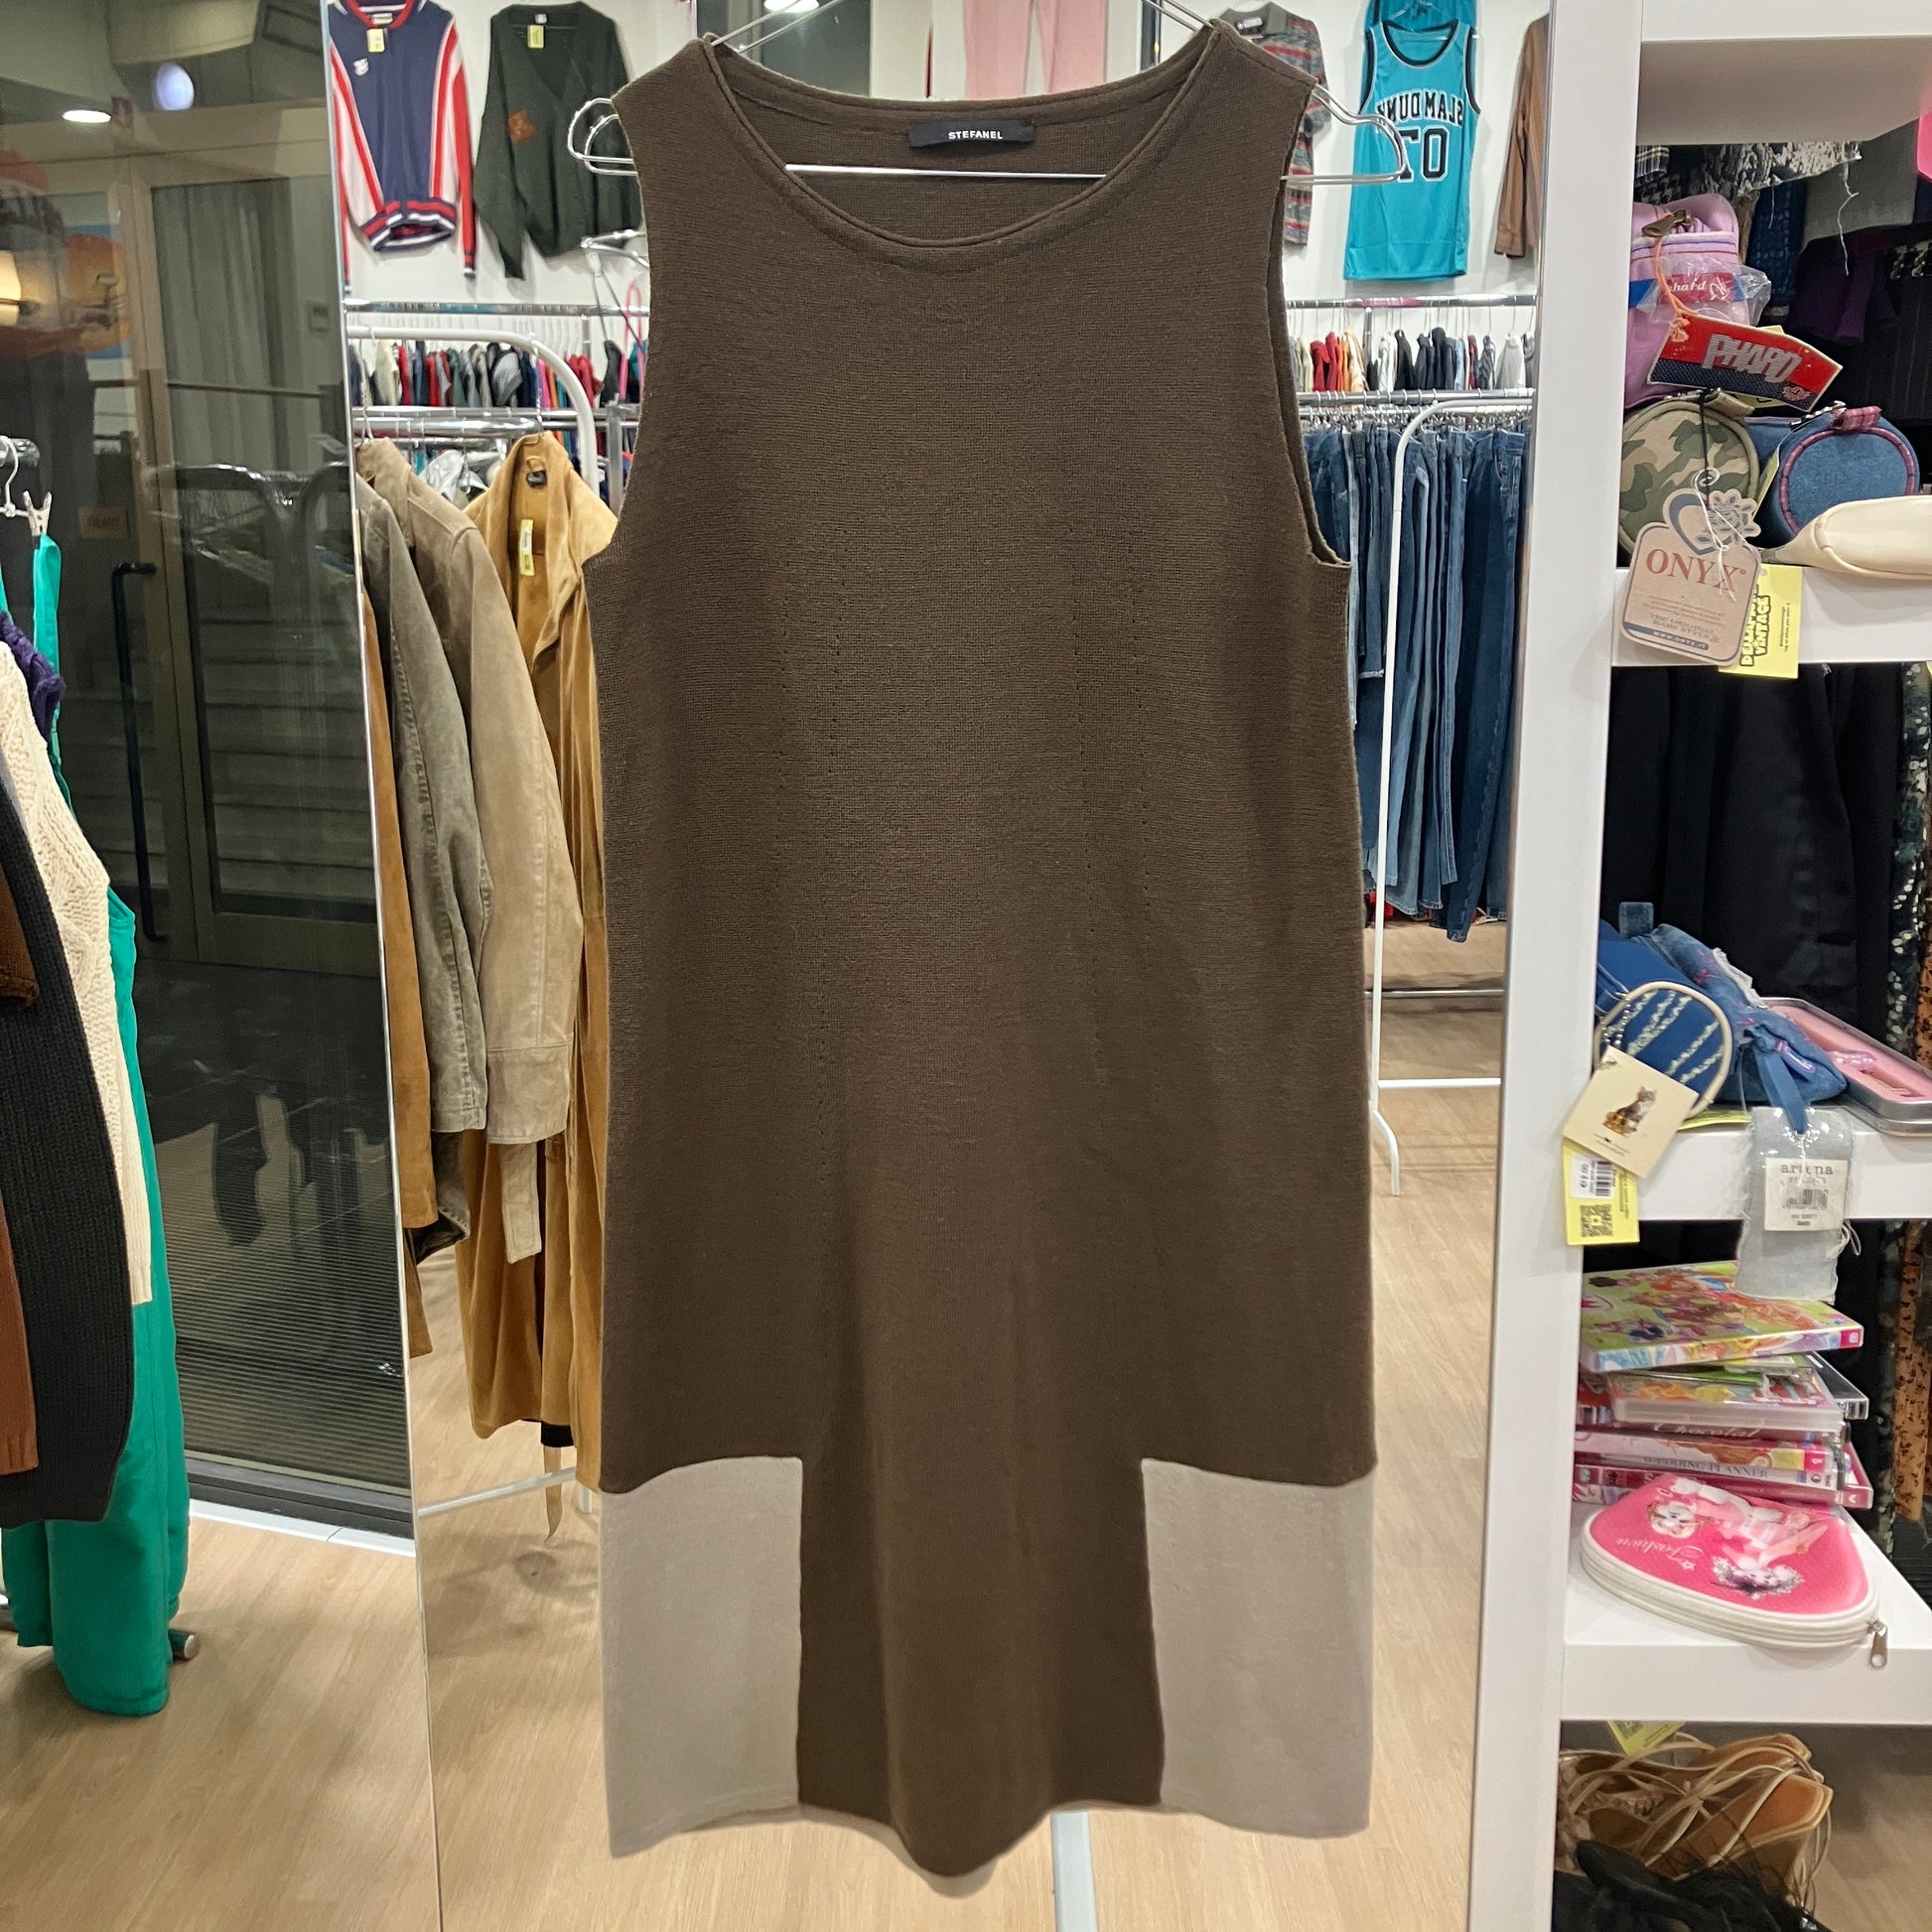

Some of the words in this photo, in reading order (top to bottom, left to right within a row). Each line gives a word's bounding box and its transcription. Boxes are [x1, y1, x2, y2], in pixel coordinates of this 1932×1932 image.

[948, 130, 1004, 140] STEFANEL
[1702, 334, 1803, 383] PHARD
[1646, 548, 1739, 593] ONYX
[1753, 595, 1771, 656] VINTAGE
